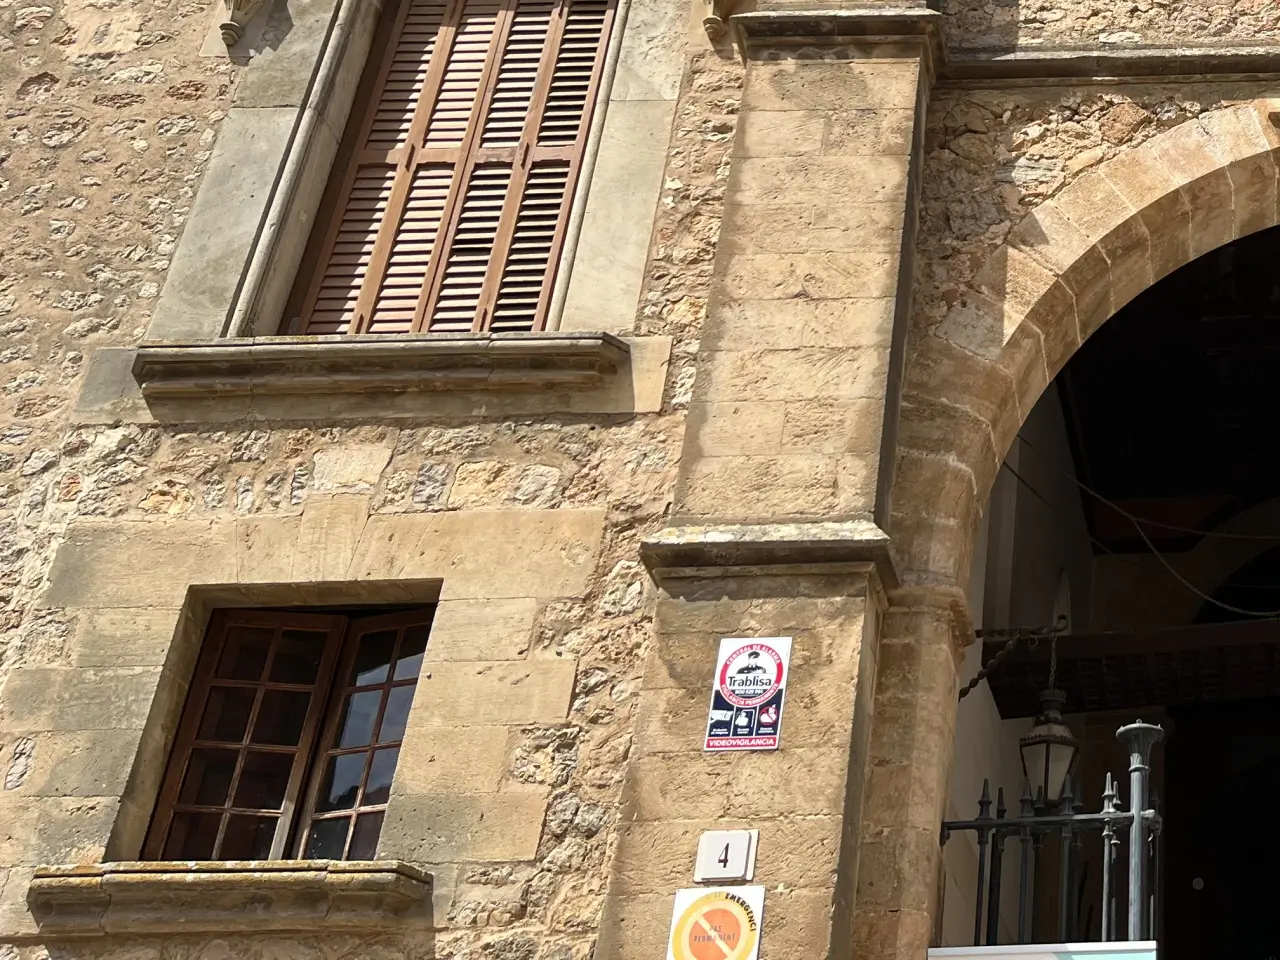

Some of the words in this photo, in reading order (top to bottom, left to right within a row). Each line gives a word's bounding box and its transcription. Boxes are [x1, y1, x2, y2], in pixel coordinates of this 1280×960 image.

[727, 645, 754, 664] CENTRAL
[762, 645, 780, 664] ALARMA
[728, 675, 772, 687] Trablisa
[709, 739, 774, 747] VIDEOVIGILANCIA
[717, 842, 731, 868] 4
